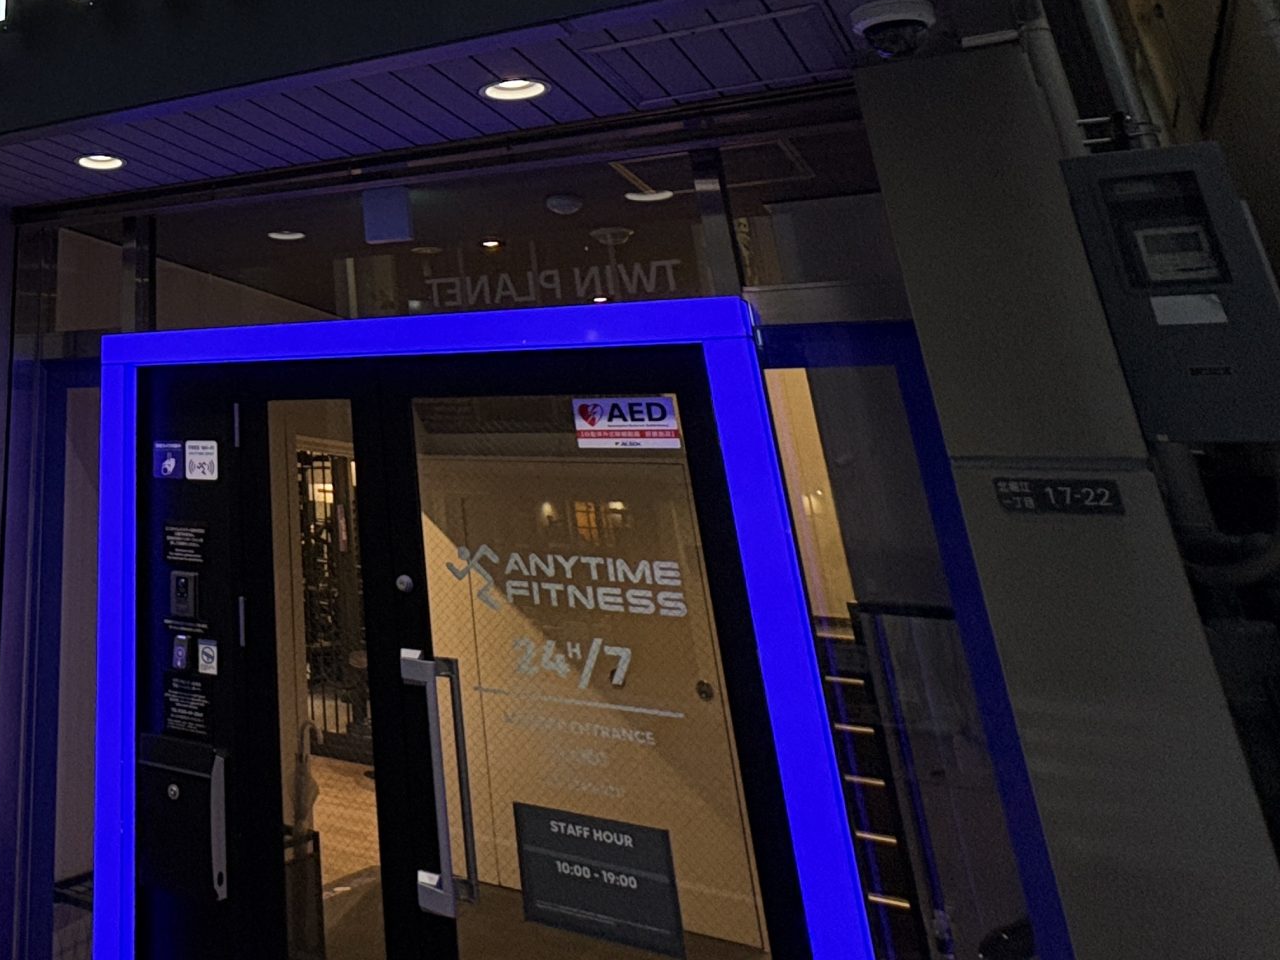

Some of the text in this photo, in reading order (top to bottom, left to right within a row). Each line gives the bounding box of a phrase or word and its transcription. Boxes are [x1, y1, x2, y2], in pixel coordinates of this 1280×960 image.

[607, 401, 667, 423] AED
[1044, 486, 1113, 506] 17-22
[504, 552, 683, 587] ANYTIME
[504, 580, 688, 619] FITNESS
[549, 820, 634, 849] STAFF HOUR
[555, 860, 591, 879] 10:00
[601, 869, 638, 890] 19:00
